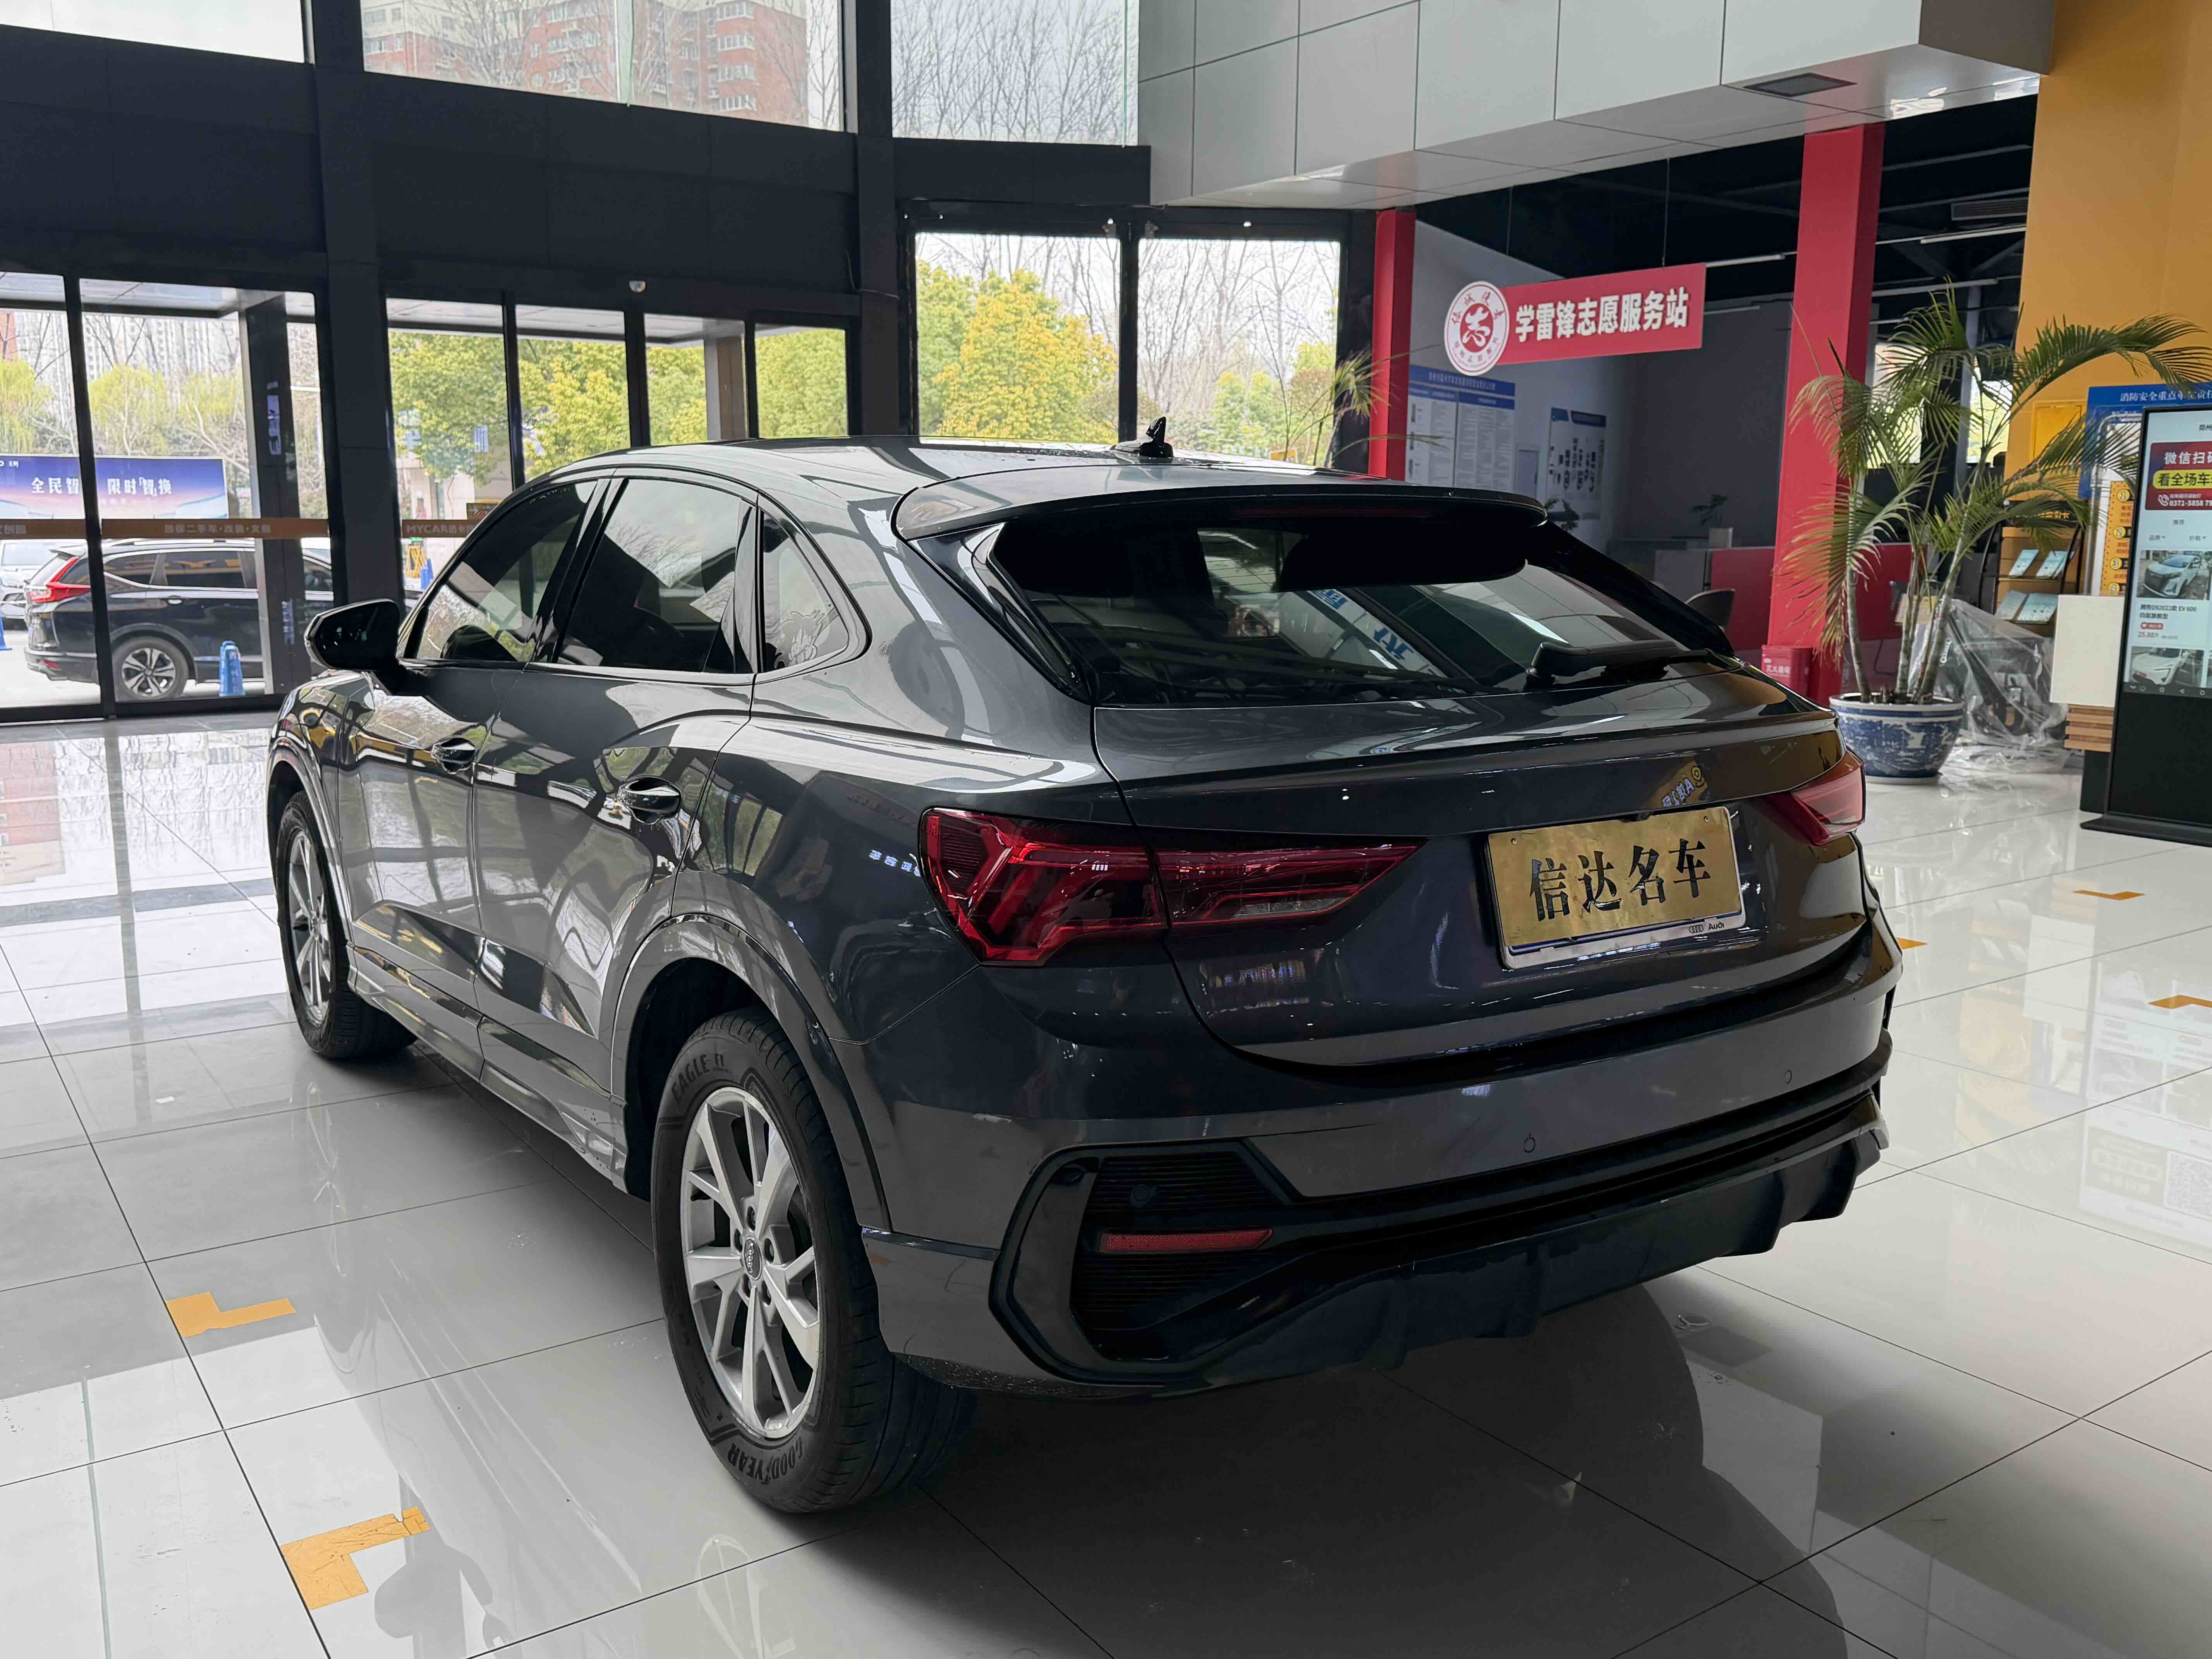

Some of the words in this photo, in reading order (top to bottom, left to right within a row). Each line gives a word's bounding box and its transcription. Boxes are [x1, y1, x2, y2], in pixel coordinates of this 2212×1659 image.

[1515, 287, 1688, 342] 学雷锋志愿服务站
[31, 477, 79, 495] 全民智
[2158, 472, 2212, 486] 看全场车
[1530, 838, 1711, 921] 信达名车
[1708, 921, 1724, 930] Audi
[672, 1054, 710, 1103] EAGLE
[728, 1435, 803, 1484] GOODYEAR
